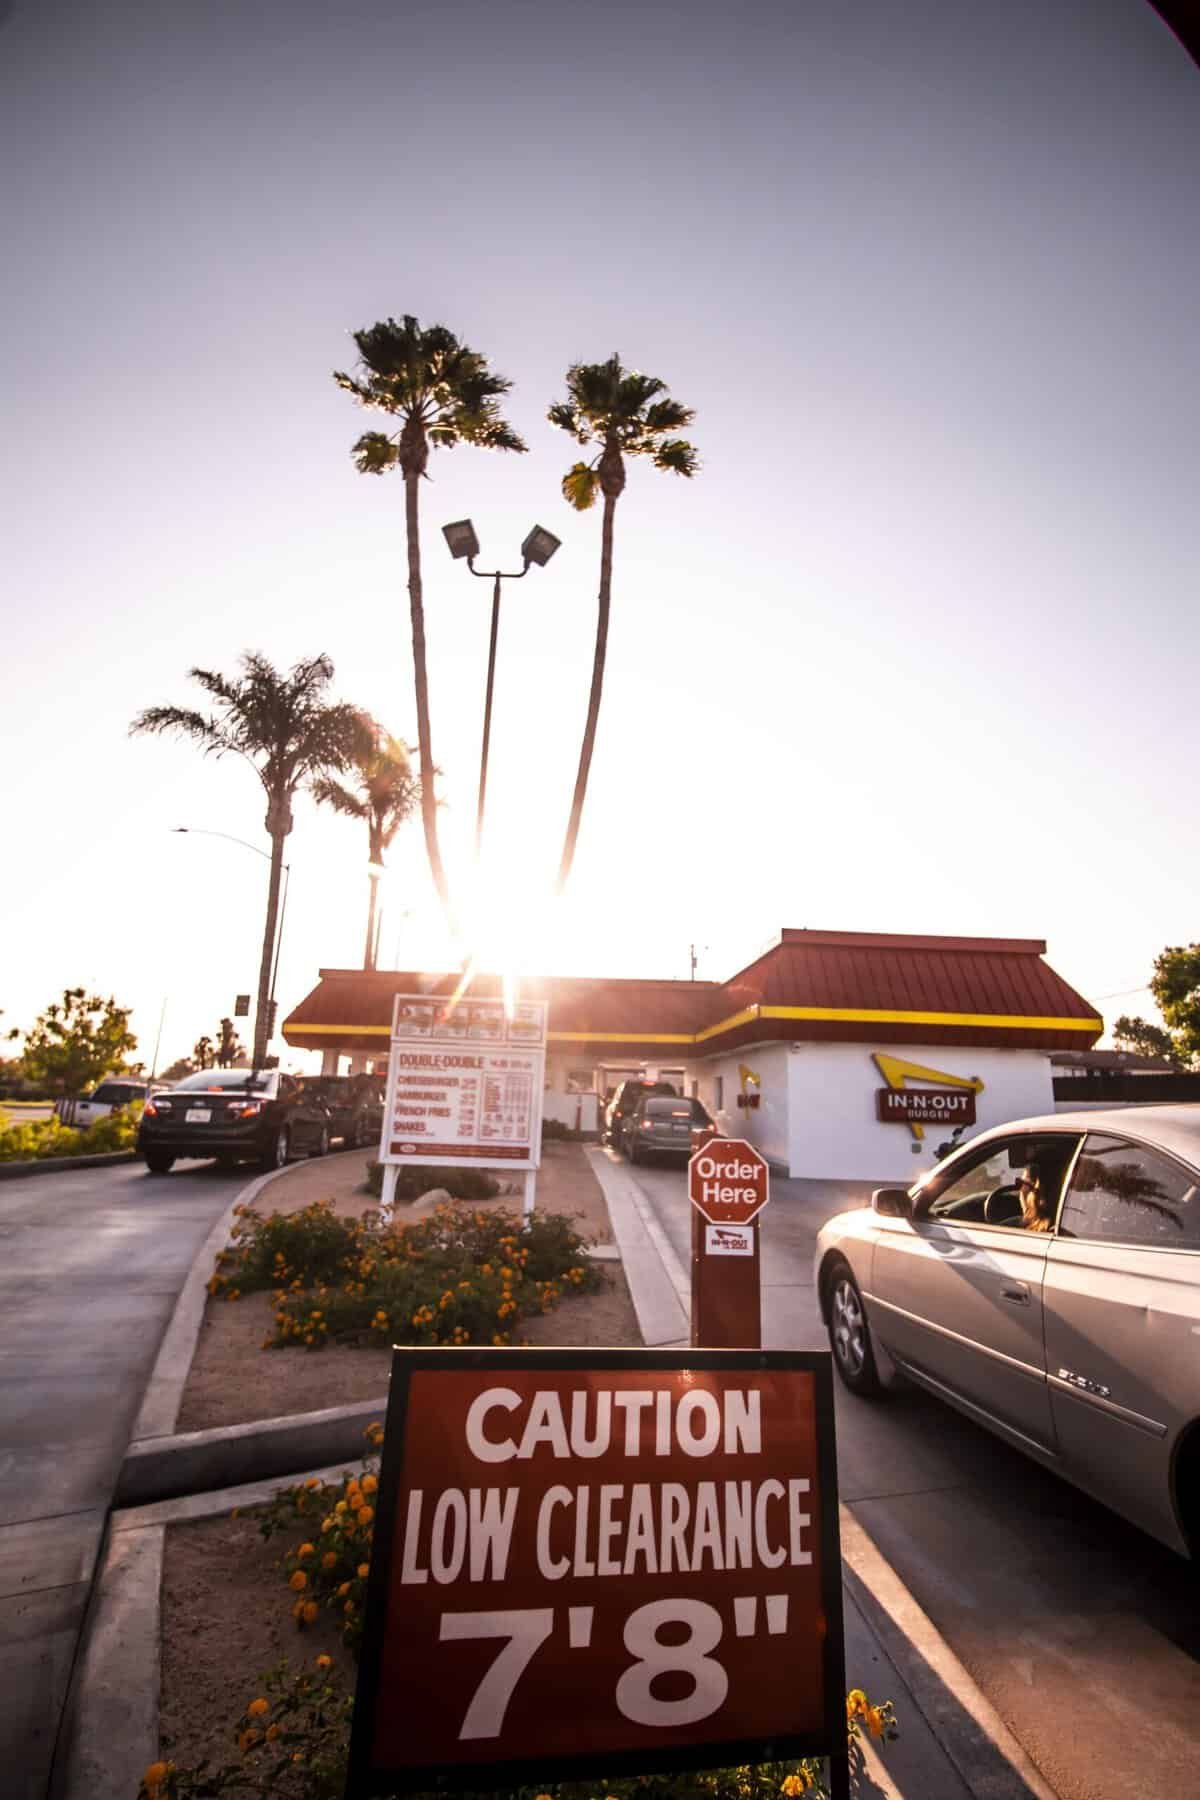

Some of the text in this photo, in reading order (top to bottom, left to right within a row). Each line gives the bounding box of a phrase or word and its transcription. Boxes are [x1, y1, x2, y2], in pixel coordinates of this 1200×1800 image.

[907, 1110, 950, 1119] BURGER
[697, 1157, 763, 1180] Order
[702, 1182, 758, 1204] Here
[465, 1387, 762, 1463] CAUTION
[401, 1479, 813, 1585] LOW CLEARANCE
